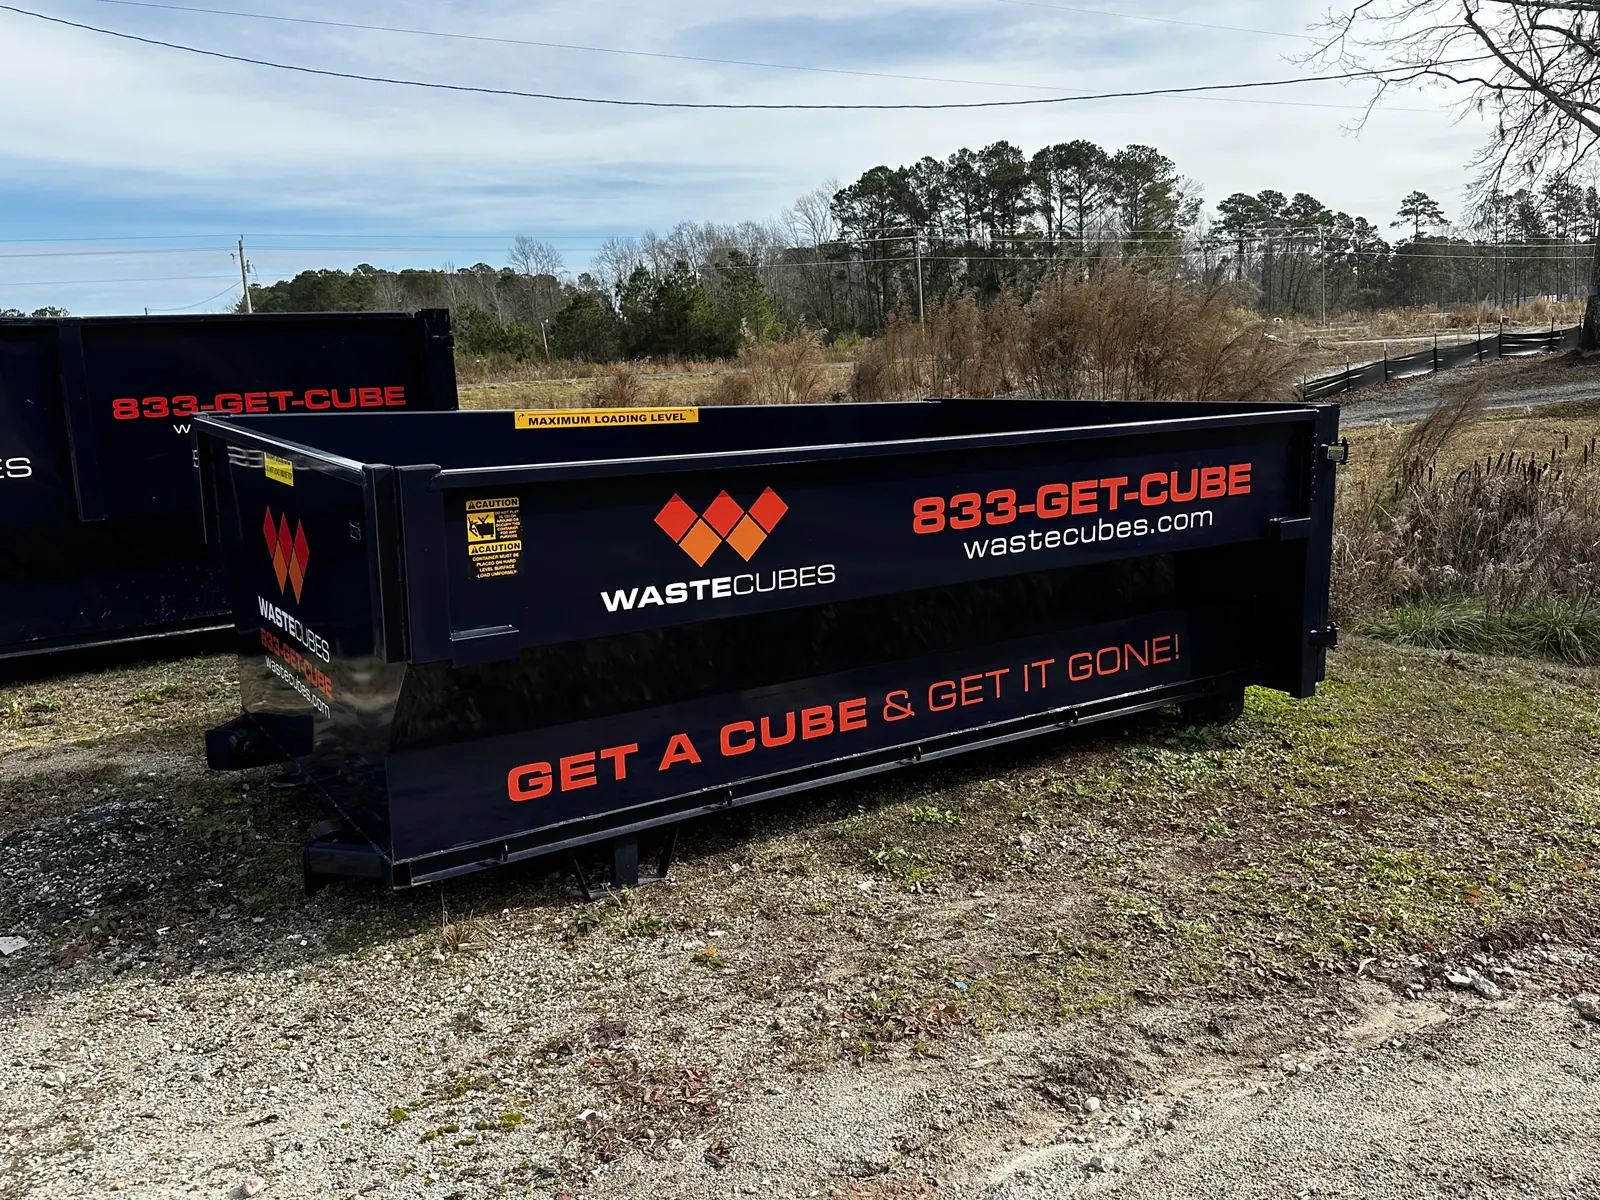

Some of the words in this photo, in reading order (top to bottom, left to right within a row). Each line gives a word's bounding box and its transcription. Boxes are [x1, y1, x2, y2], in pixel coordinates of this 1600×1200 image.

[111, 386, 406, 420] 833-GET-CUBE
[528, 416, 591, 426] MAXIMUM
[595, 414, 647, 424] LOADING
[650, 412, 687, 422] LEVEL
[475, 498, 518, 508] CAUTION
[912, 463, 1252, 535] 833-GET-CUBE
[478, 542, 520, 552] CAUTION
[963, 509, 1213, 560] wastecubes.com
[600, 563, 836, 613] WASTECUBES
[257, 595, 331, 664] WASTECUBES
[260, 627, 333, 700] 833-GET-CUBE
[264, 655, 331, 720] wastecubes.com
[507, 743, 639, 802] GET
[658, 733, 702, 771] A
[719, 697, 868, 757] CUBE
[882, 689, 915, 722] &
[927, 667, 1010, 712] GET
[1023, 658, 1055, 692] IT
[1067, 635, 1180, 682] GONE!
